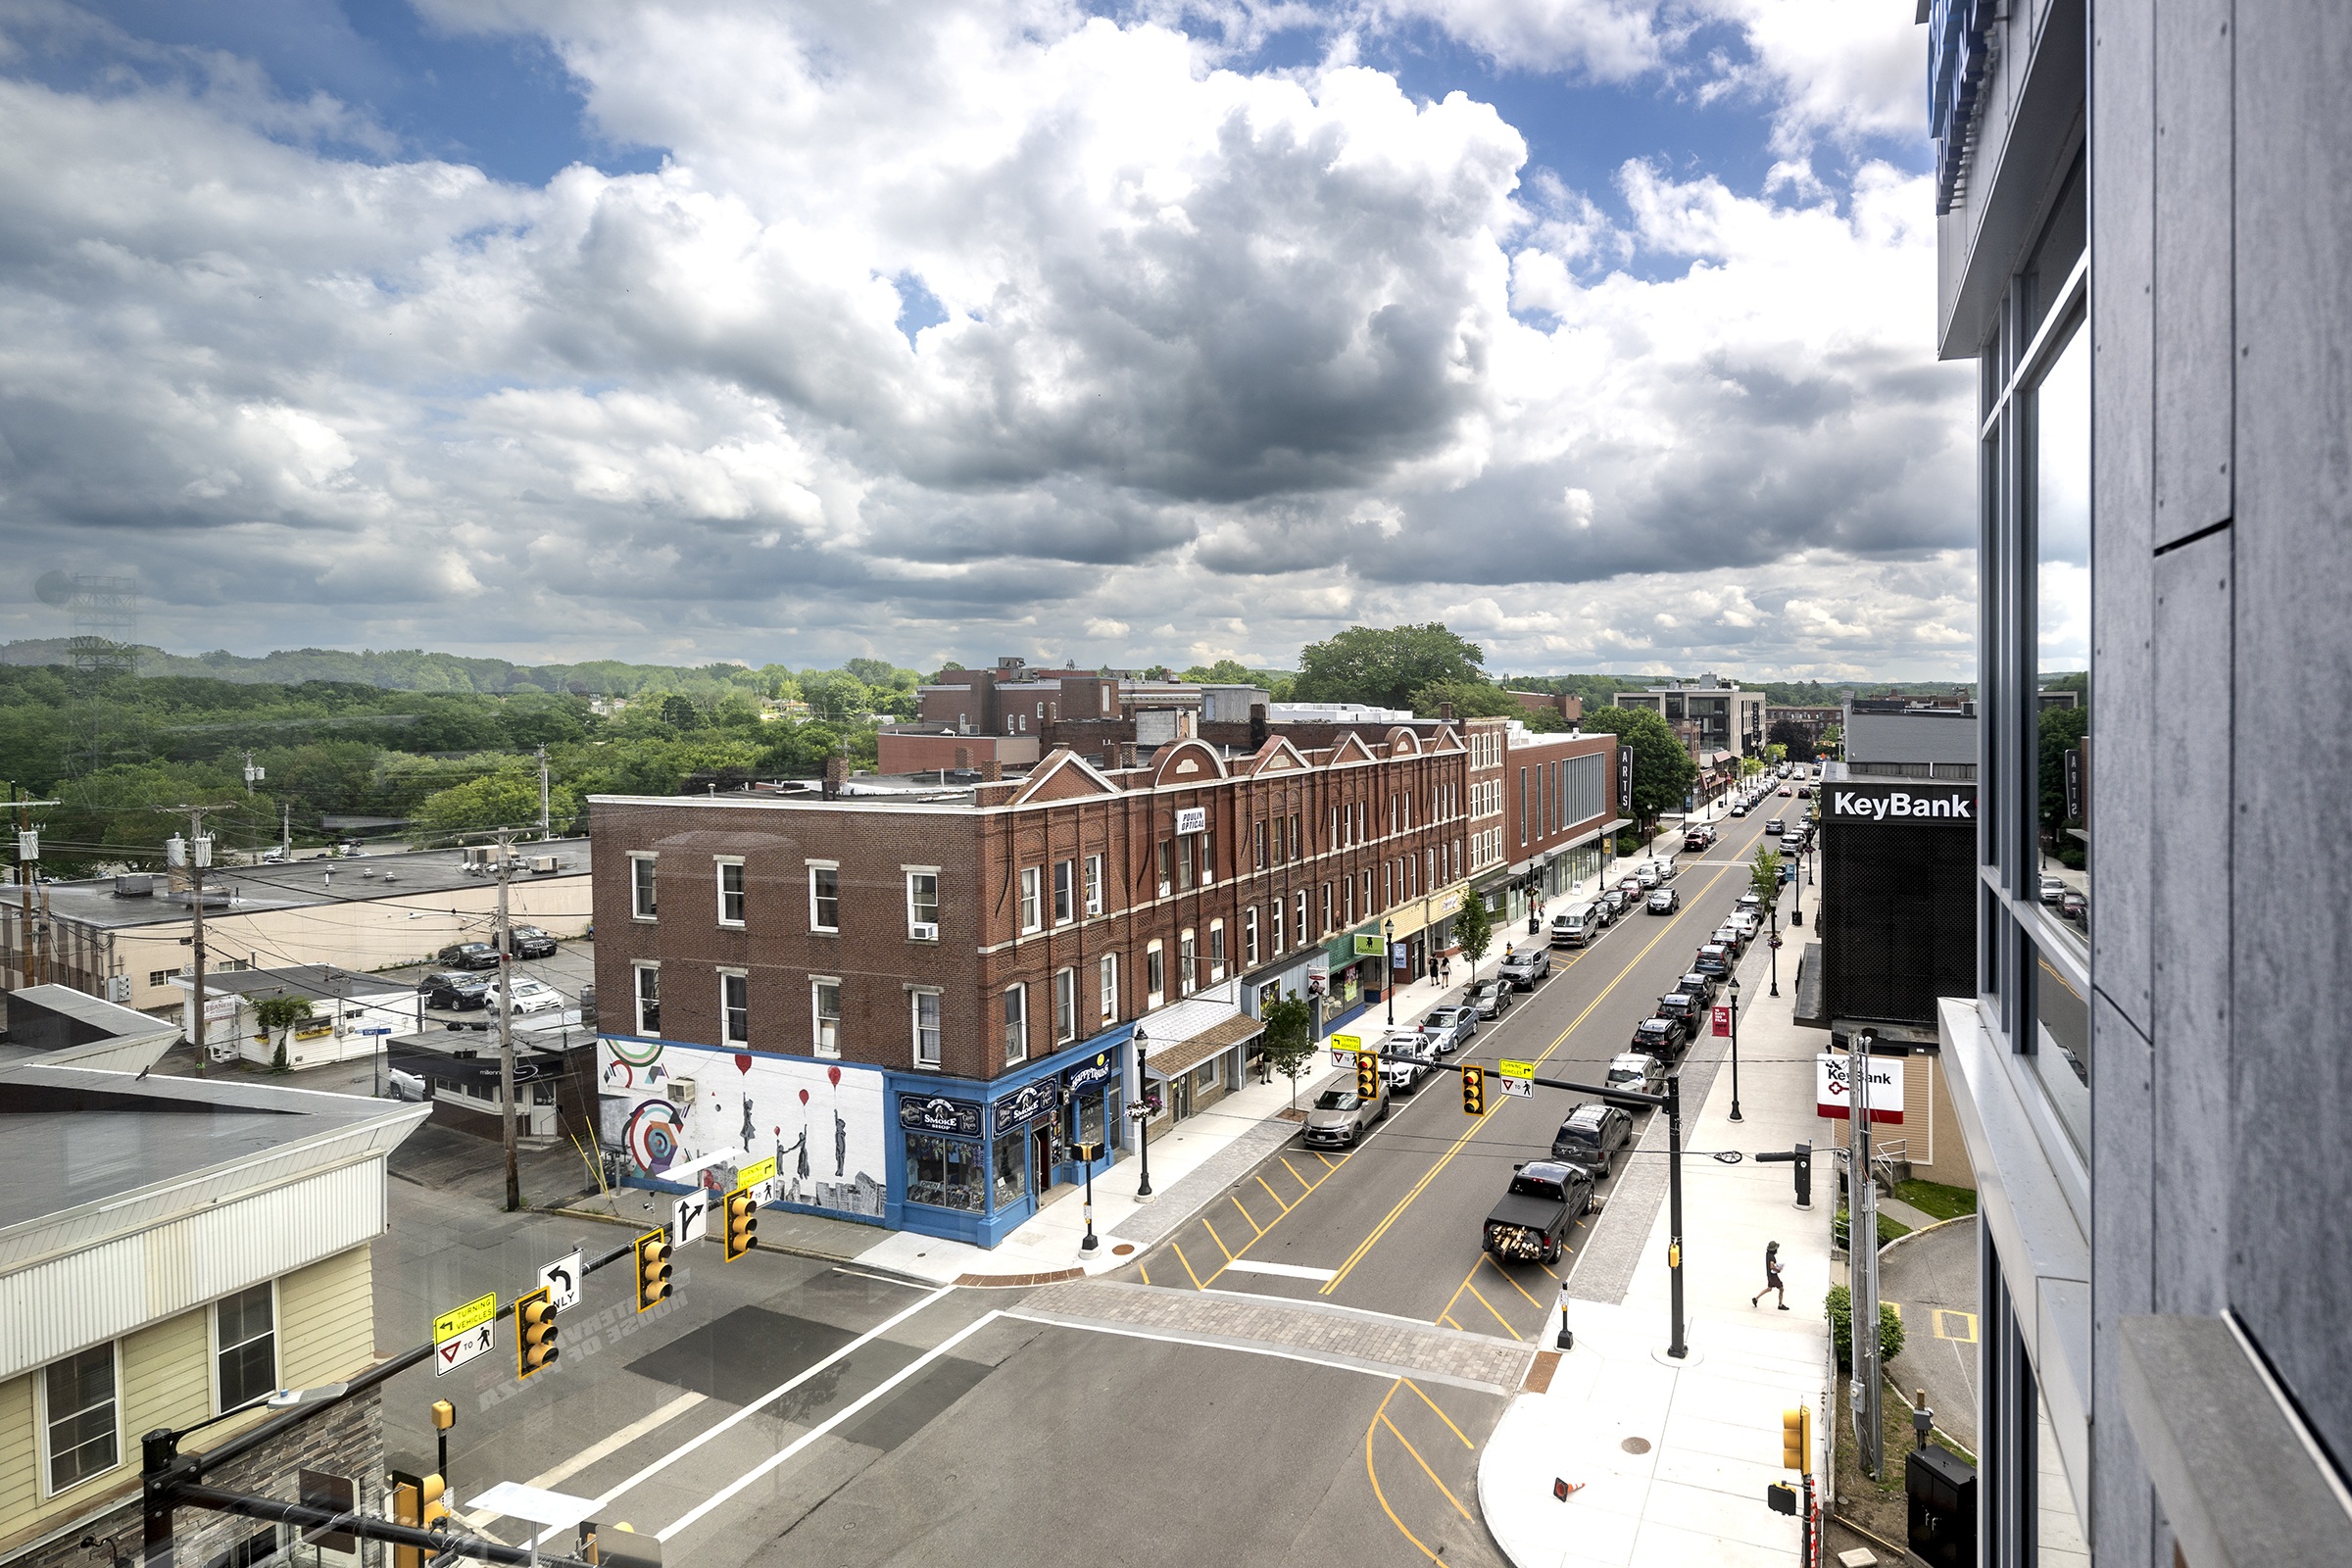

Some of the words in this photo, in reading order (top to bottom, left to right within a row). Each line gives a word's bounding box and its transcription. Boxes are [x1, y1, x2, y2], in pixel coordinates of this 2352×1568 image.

[1835, 792, 1971, 821] KeyBank
[1182, 811, 1204, 822] POULIN
[1181, 819, 1204, 831] OPTICAL
[205, 1002, 234, 1013] EBANESE
[1013, 1100, 1039, 1119] SMOKE
[1018, 1110, 1034, 1121] SHOP
[924, 1113, 957, 1127] SMOKE
[553, 1292, 575, 1308] NLY
[457, 1298, 491, 1319] TURNING
[456, 1308, 493, 1330] VEHICLES
[463, 1341, 474, 1350] TO
